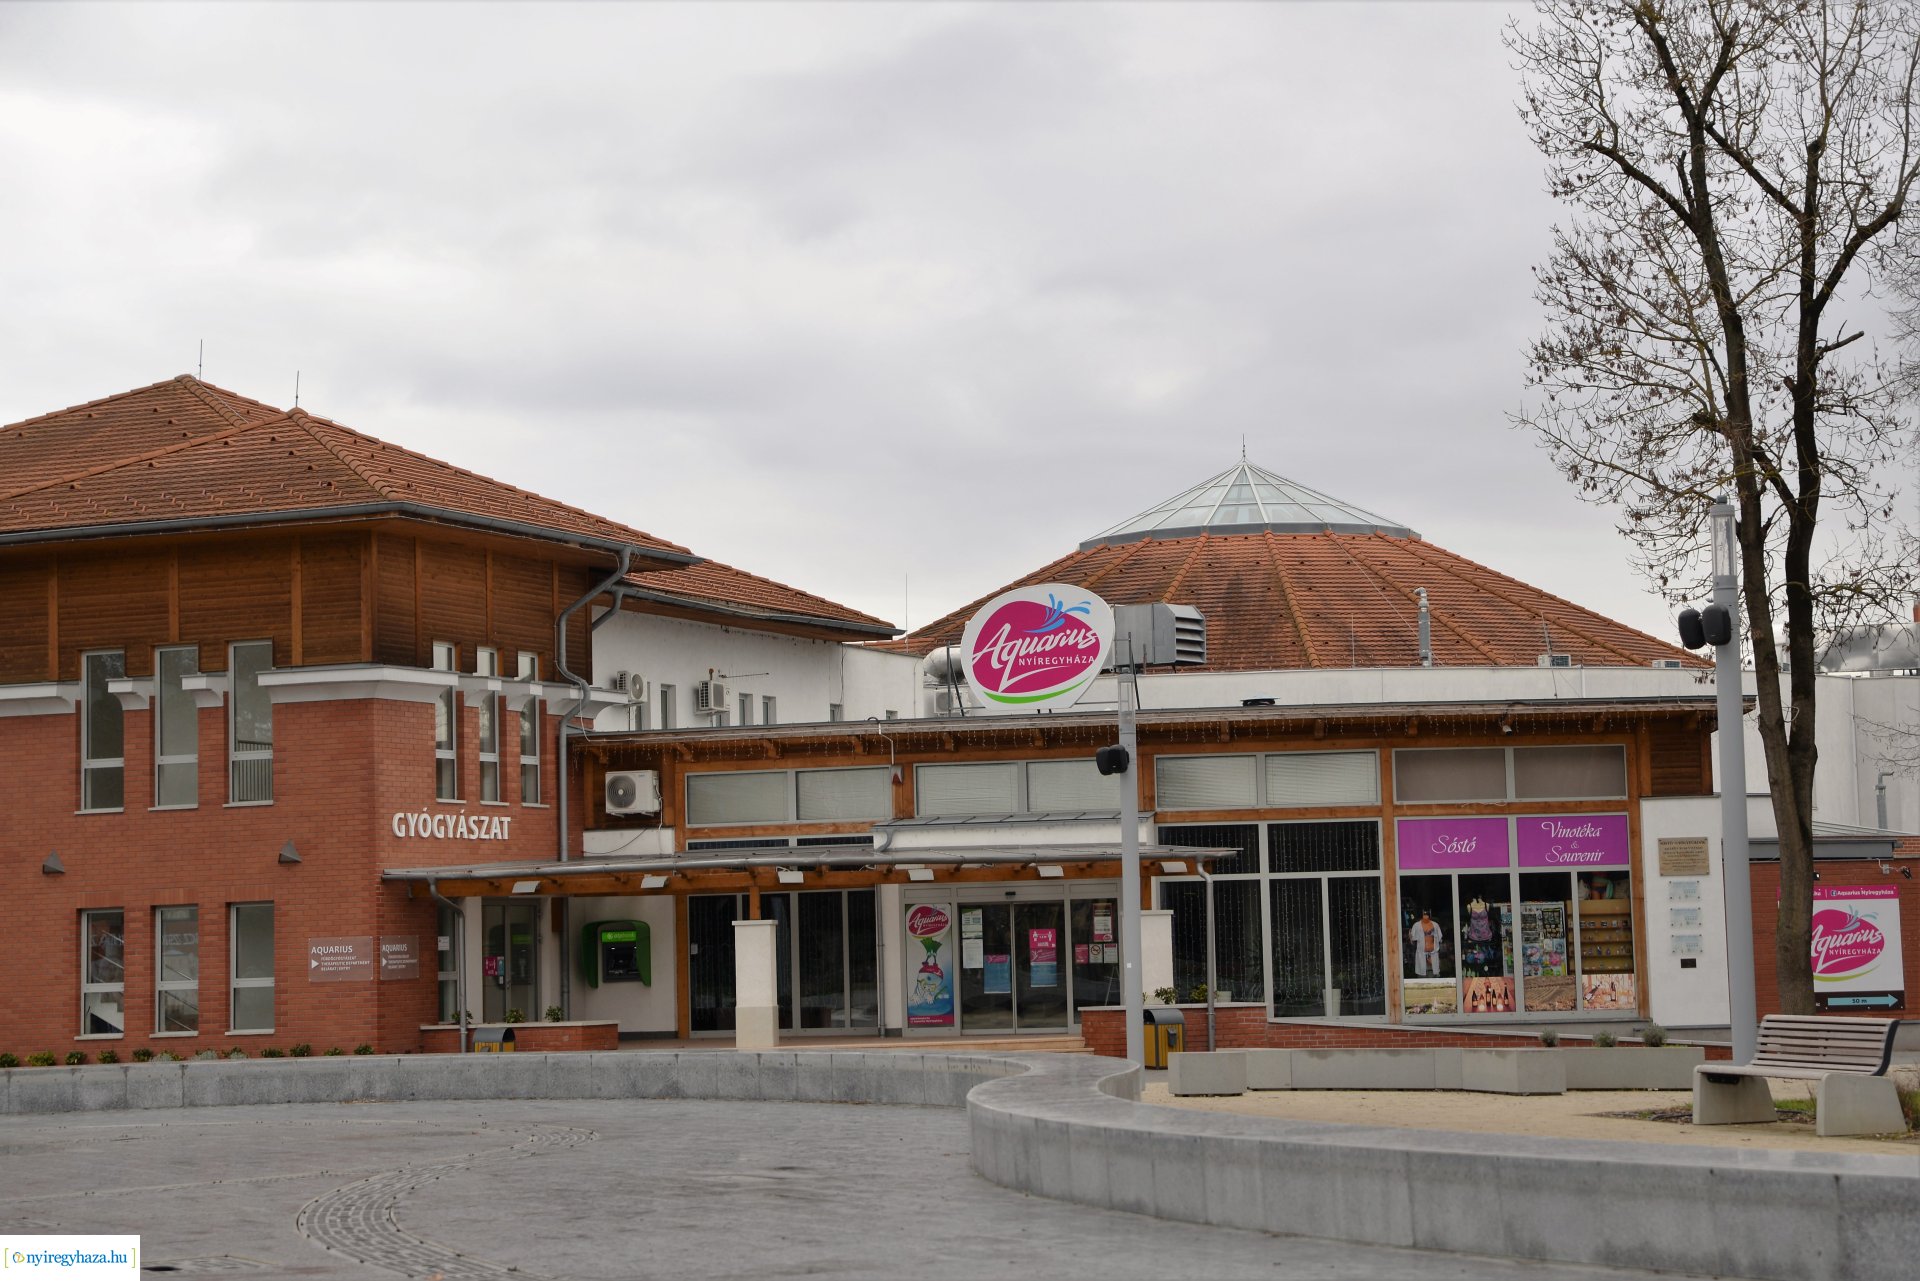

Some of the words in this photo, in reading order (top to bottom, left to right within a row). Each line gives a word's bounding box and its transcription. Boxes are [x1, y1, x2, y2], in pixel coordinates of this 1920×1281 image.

[972, 623, 1100, 692] Aquarius
[1018, 654, 1096, 667] NYÍREGYHÁZA
[391, 807, 511, 840] GYÓGYÁSZAT
[1541, 821, 1602, 838] Vinotéka
[1431, 835, 1477, 854] Sóstó
[1570, 841, 1580, 849] &
[1545, 845, 1605, 863] Souvenir
[311, 945, 353, 955] AQUARIUS
[1811, 924, 1882, 973] Aquarius
[1829, 948, 1881, 956] NYÍREGYHÁZA
